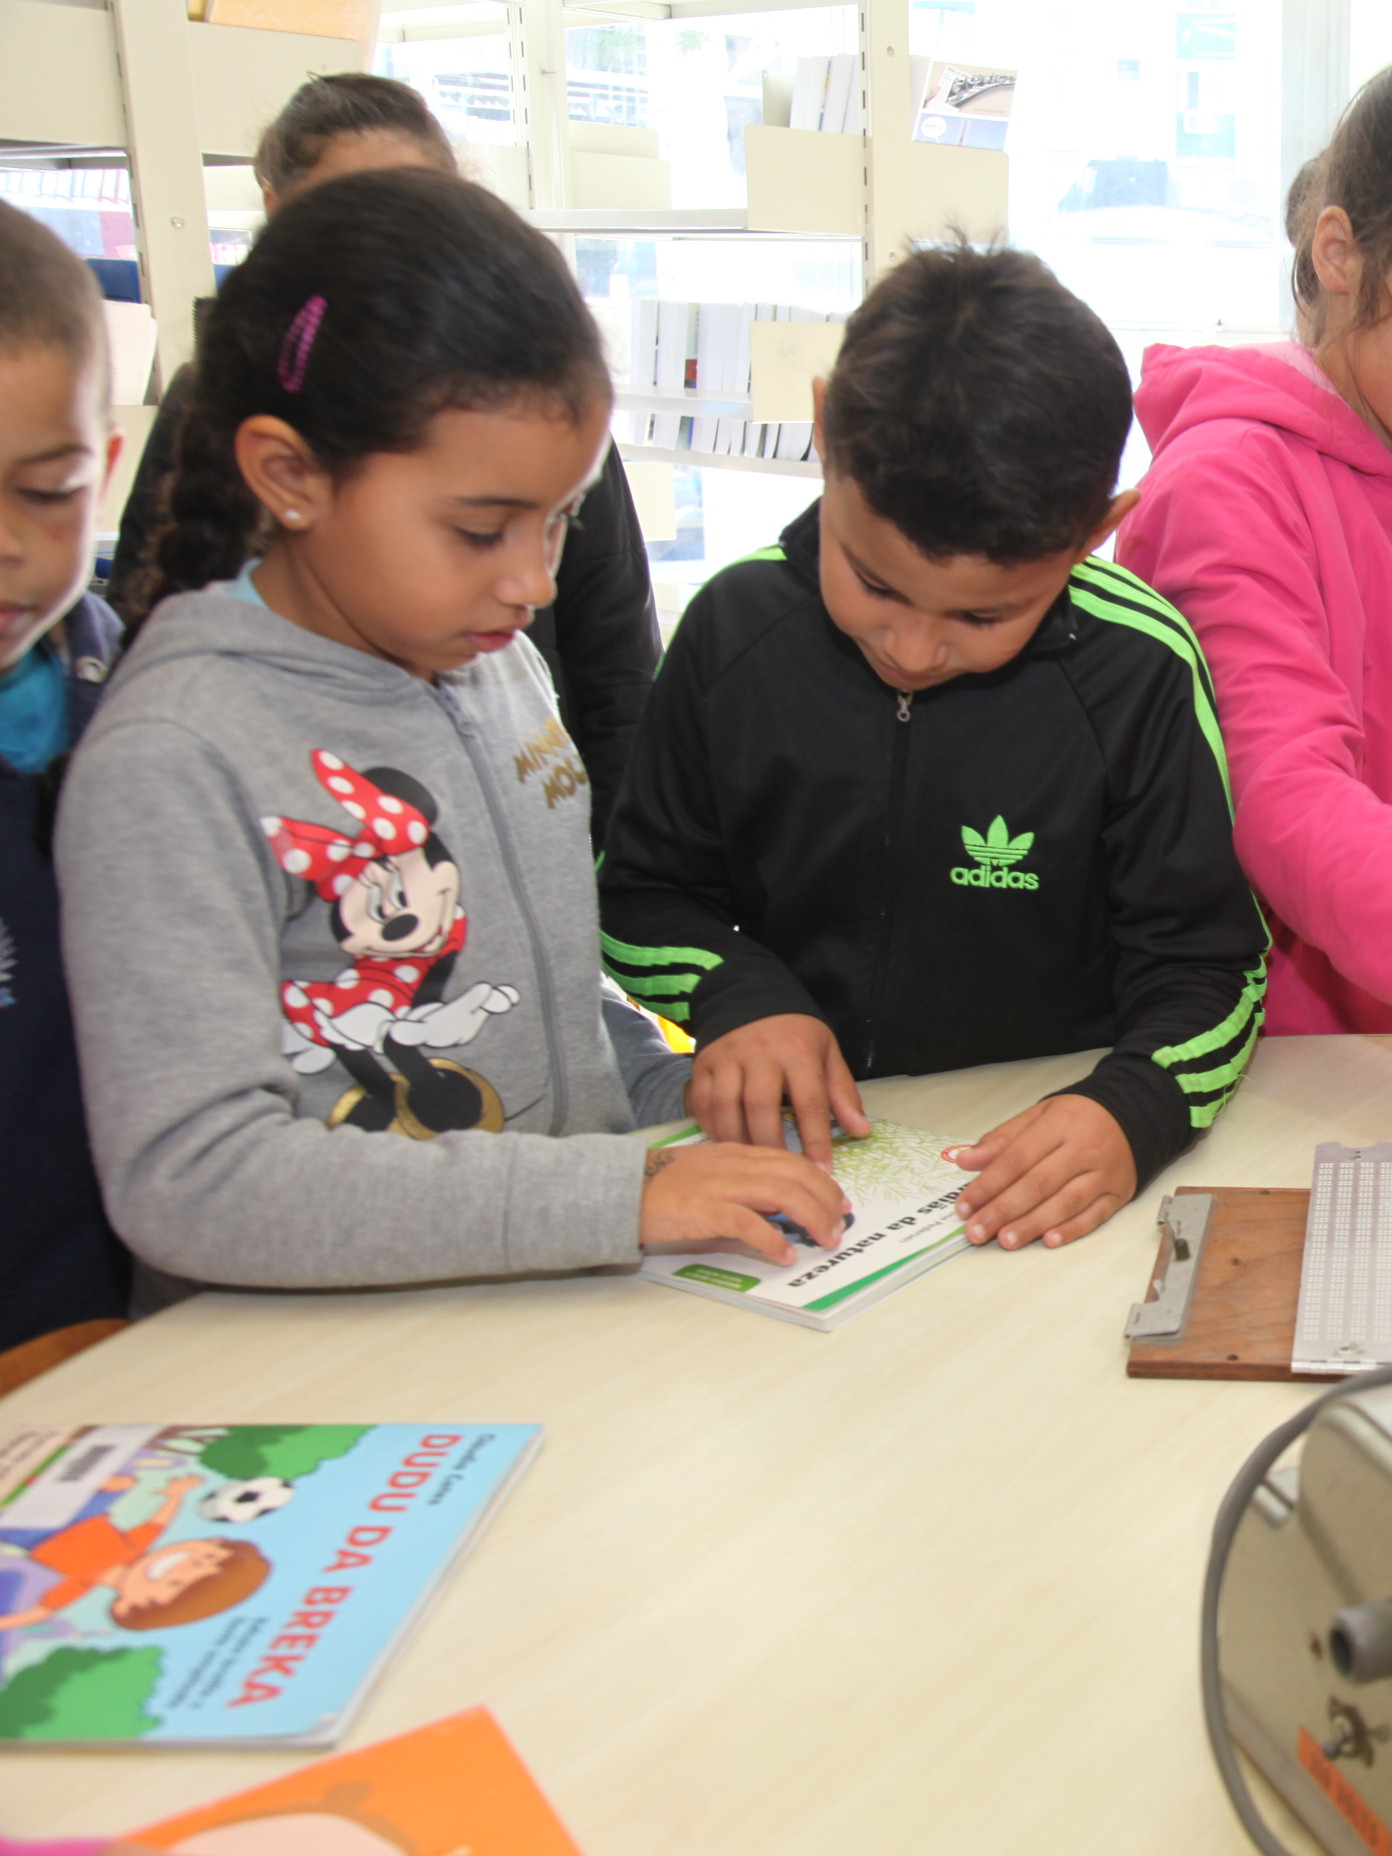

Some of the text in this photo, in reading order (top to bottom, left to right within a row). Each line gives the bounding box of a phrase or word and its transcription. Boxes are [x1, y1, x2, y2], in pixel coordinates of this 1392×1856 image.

[950, 864, 1039, 890] adidas
[787, 1182, 973, 1288] rdiãs da natureza
[368, 1433, 465, 1513] DUDU
[324, 1525, 394, 1573] DA
[226, 1585, 354, 1707] BREKA
